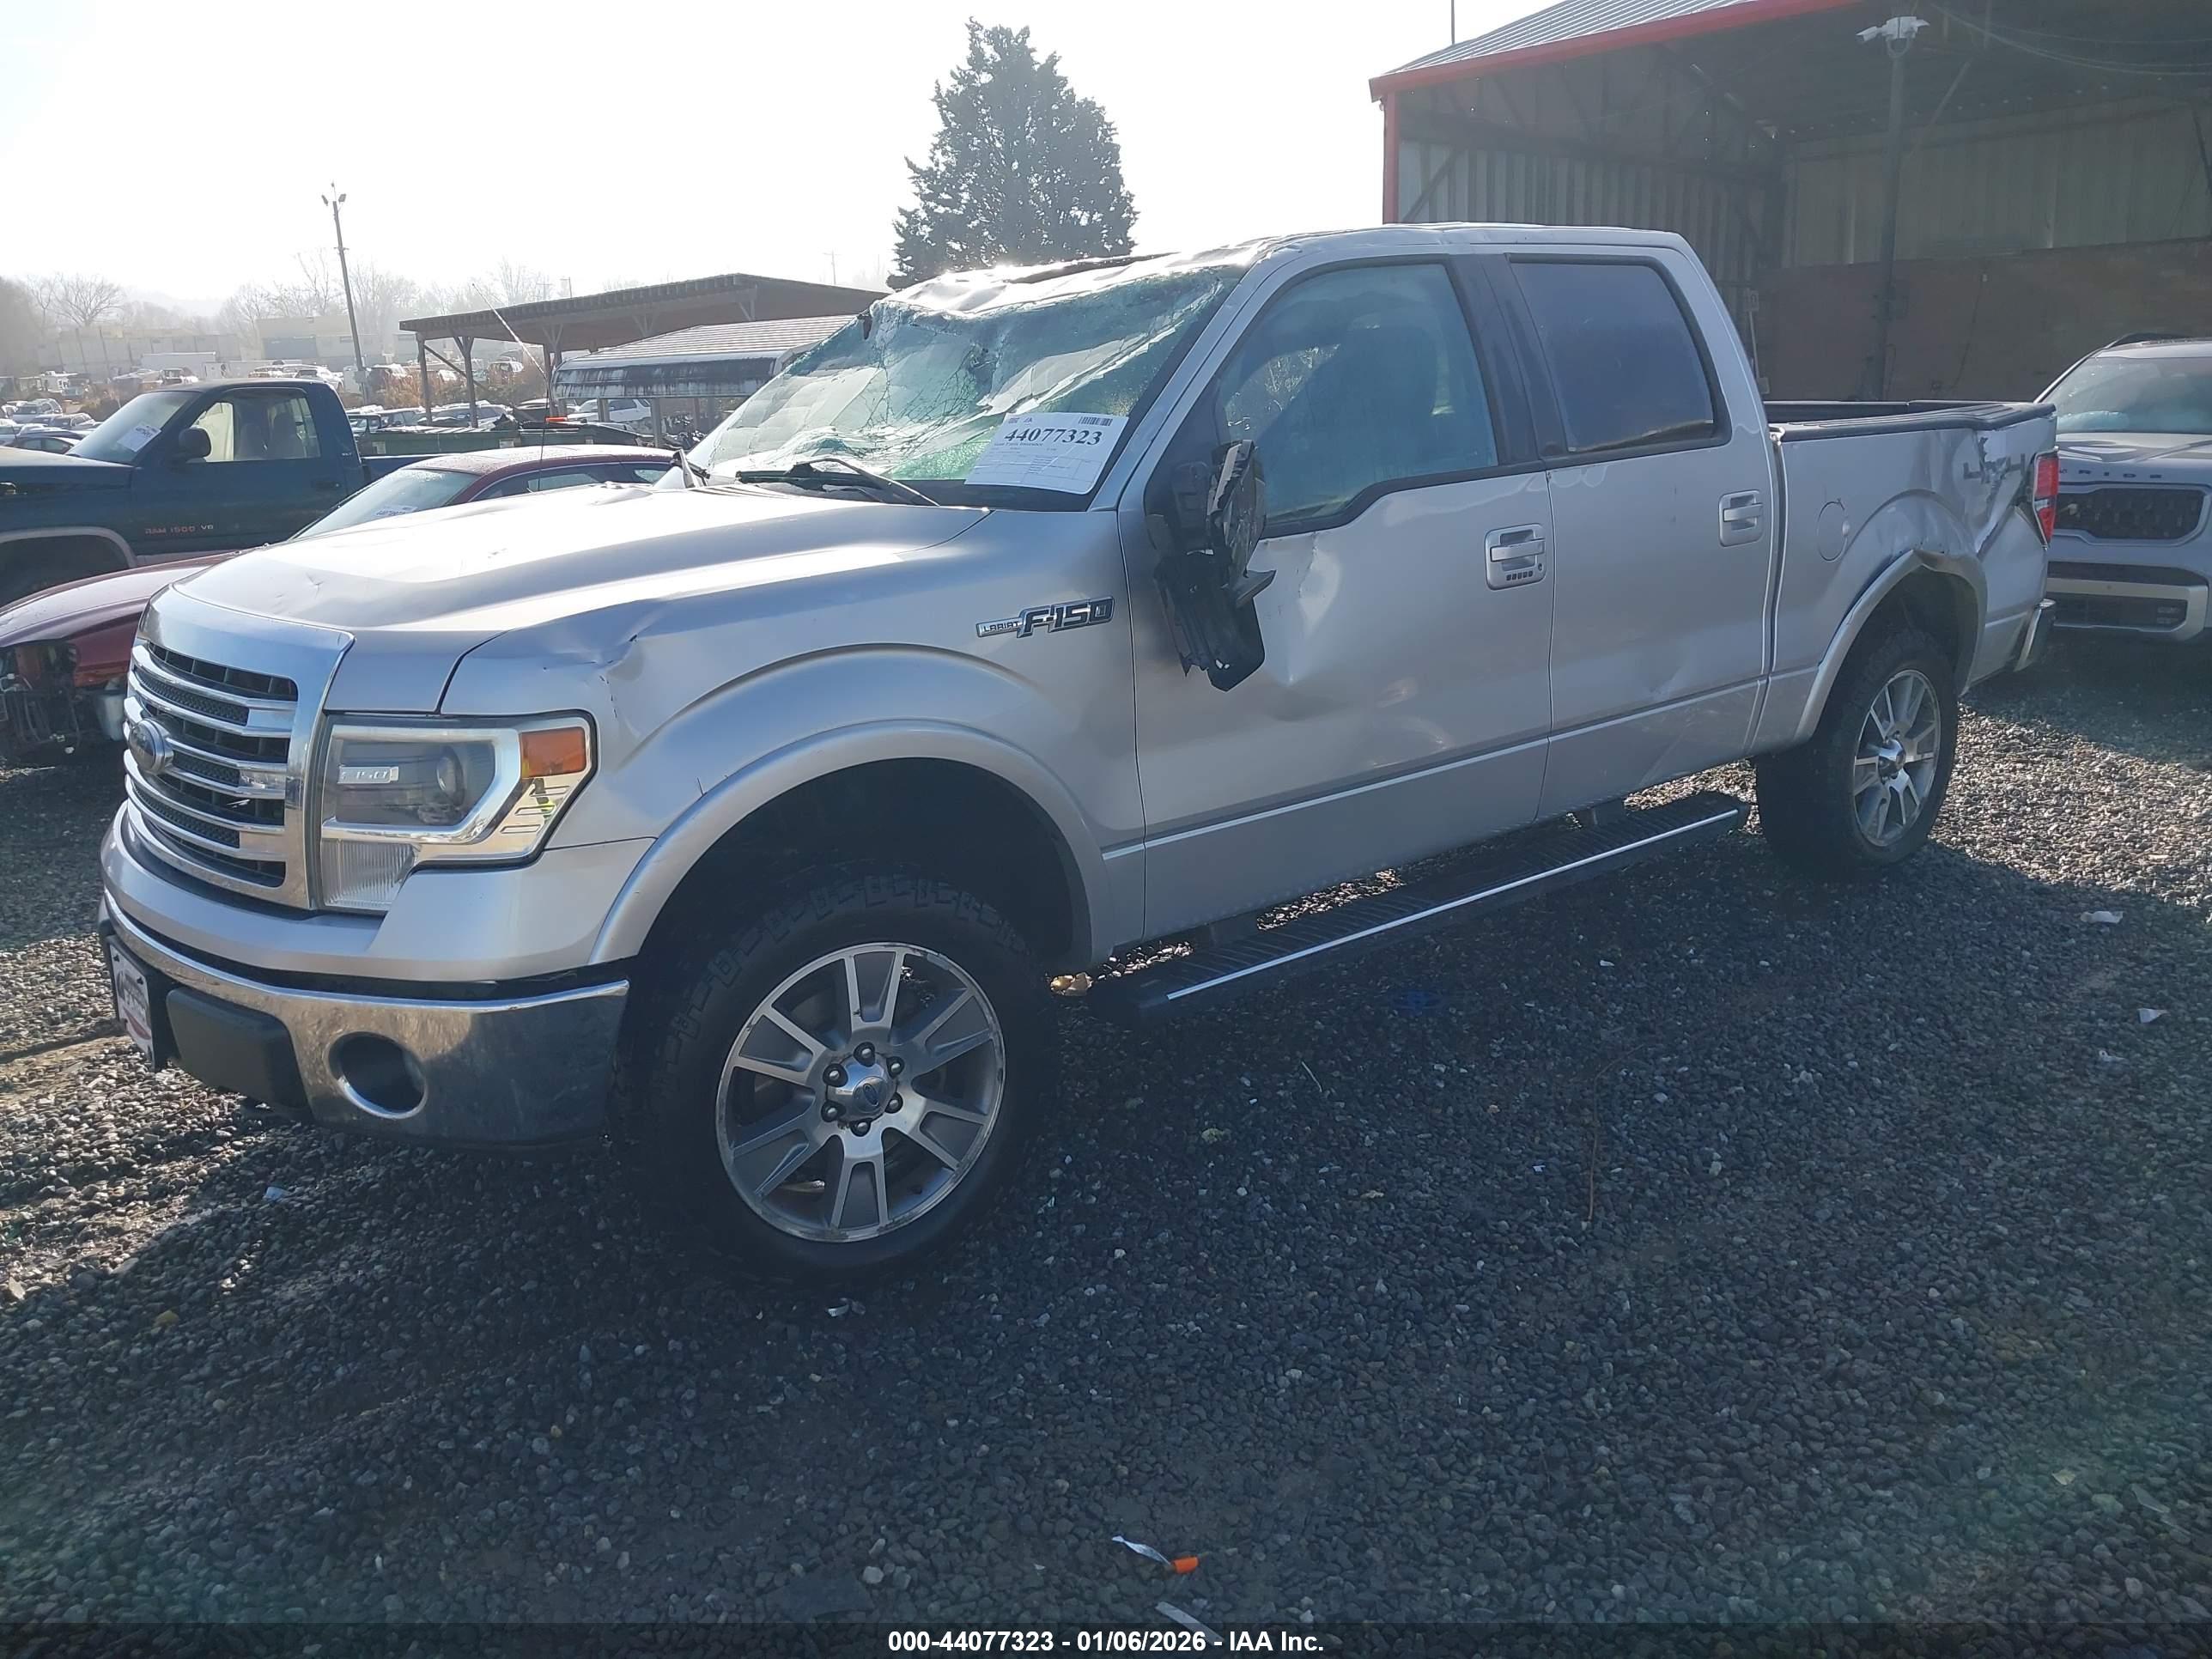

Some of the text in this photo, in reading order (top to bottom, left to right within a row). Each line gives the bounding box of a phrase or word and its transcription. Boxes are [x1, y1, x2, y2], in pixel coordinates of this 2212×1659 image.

[1004, 428, 1103, 445] 44077323
[982, 597, 1115, 638] LARIAT F-150
